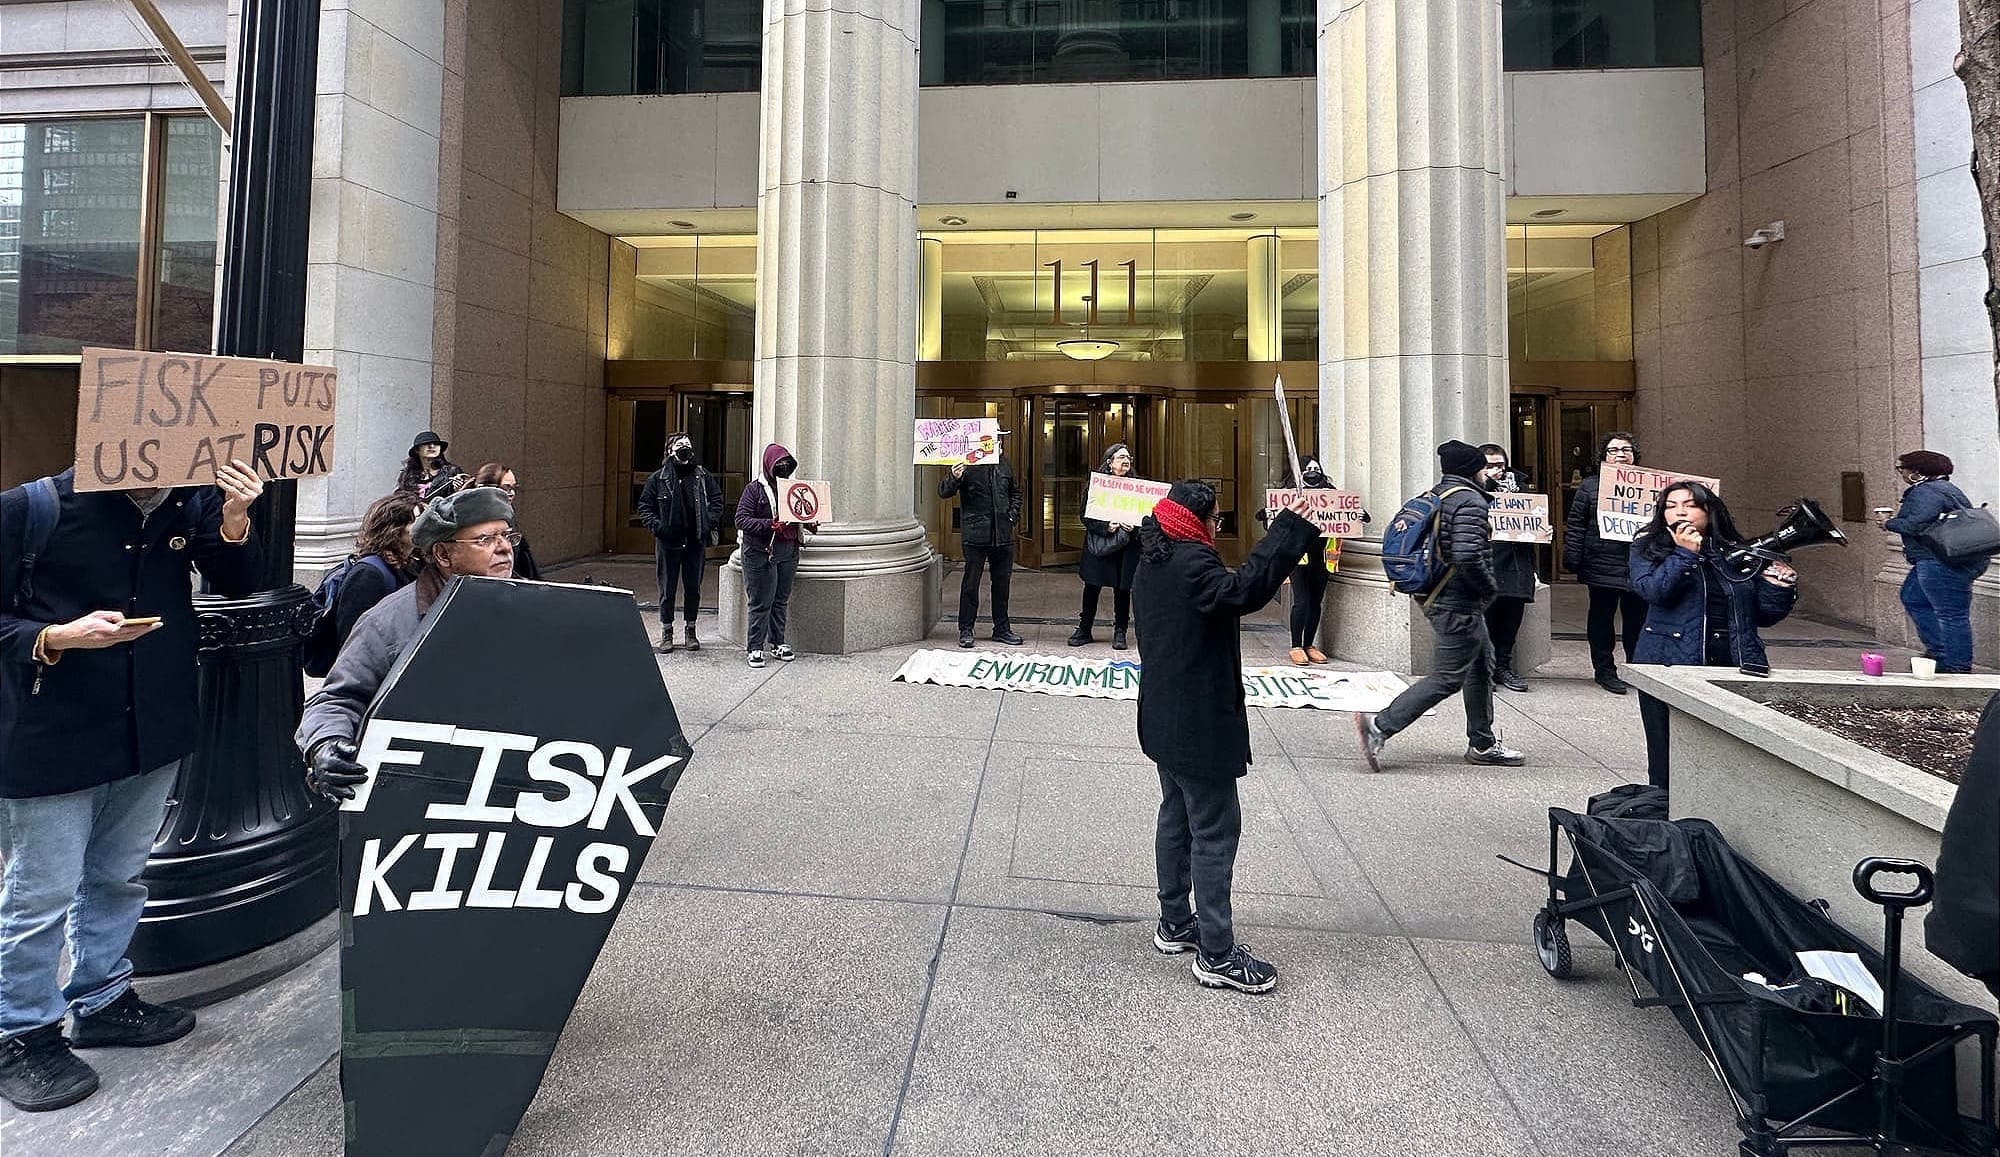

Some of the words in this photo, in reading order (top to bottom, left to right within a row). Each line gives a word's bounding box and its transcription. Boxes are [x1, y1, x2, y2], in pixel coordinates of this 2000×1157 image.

[1044, 259, 1136, 327] 111
[91, 356, 226, 427] FISK
[258, 368, 338, 412] PUTS
[94, 438, 160, 484] US
[186, 433, 246, 480] AT
[252, 422, 333, 478] RISK
[1614, 484, 1644, 500] NOT
[1617, 469, 1645, 485] NOT
[1317, 511, 1341, 521] WANT
[1345, 511, 1358, 521] TO
[1504, 498, 1533, 511] WANT
[1606, 497, 1639, 516] THE
[1523, 515, 1542, 532] AIR
[967, 658, 1141, 690] ENVIRONMEN
[1242, 675, 1330, 700] STICE
[339, 718, 684, 837] FISK
[352, 831, 631, 918] KILLS
